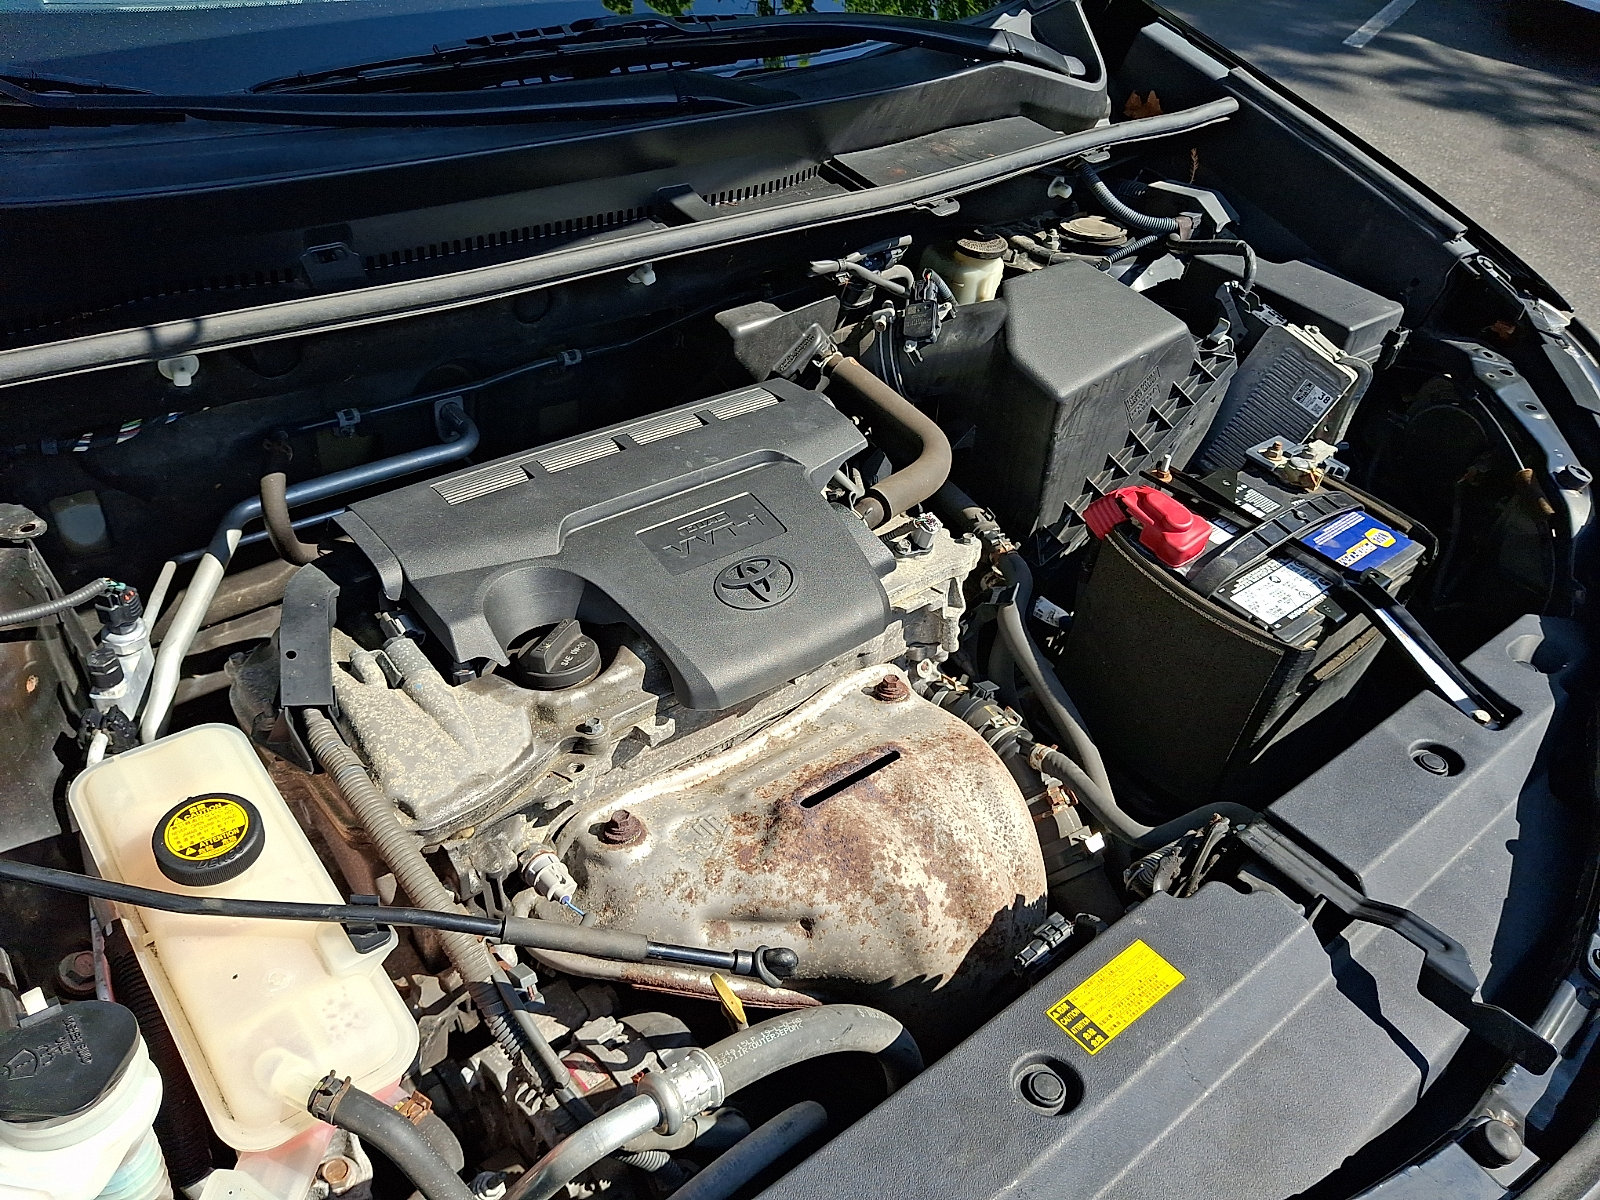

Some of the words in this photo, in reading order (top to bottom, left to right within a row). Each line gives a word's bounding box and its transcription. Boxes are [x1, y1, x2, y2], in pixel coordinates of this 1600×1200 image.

[1318, 392, 1331, 404] 38
[184, 802, 222, 820] CAUTION
[199, 827, 240, 848] ATTENTION
[1060, 1007, 1081, 1026] CAUTION
[1070, 1016, 1091, 1035] ATTENTION
[716, 1022, 804, 1069] ER>IIR<OUTER>EPDM<
